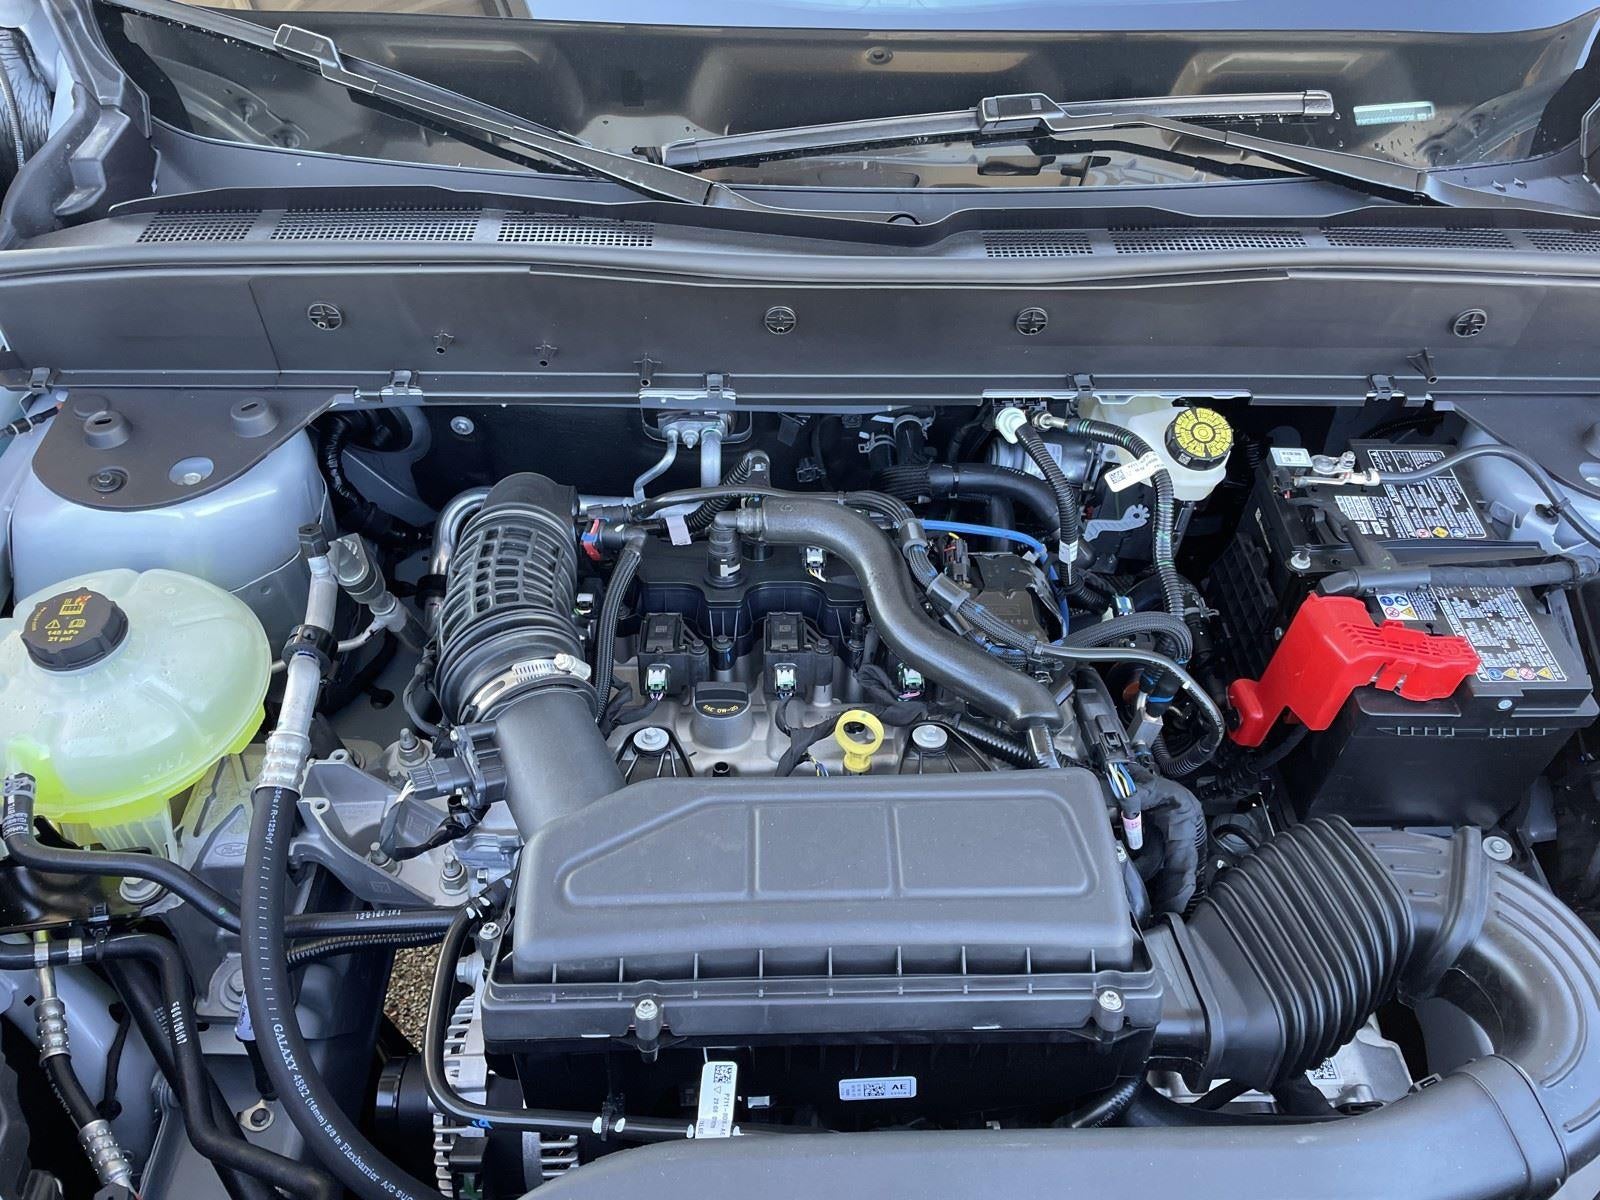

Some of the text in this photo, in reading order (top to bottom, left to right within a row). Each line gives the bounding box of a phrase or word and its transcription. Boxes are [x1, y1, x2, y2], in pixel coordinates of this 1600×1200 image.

[273, 1023, 298, 1071] GALAXY
[293, 1073, 310, 1098] 4882
[304, 1097, 328, 1127] (16mm)
[339, 1142, 380, 1183] Flexbarrier
